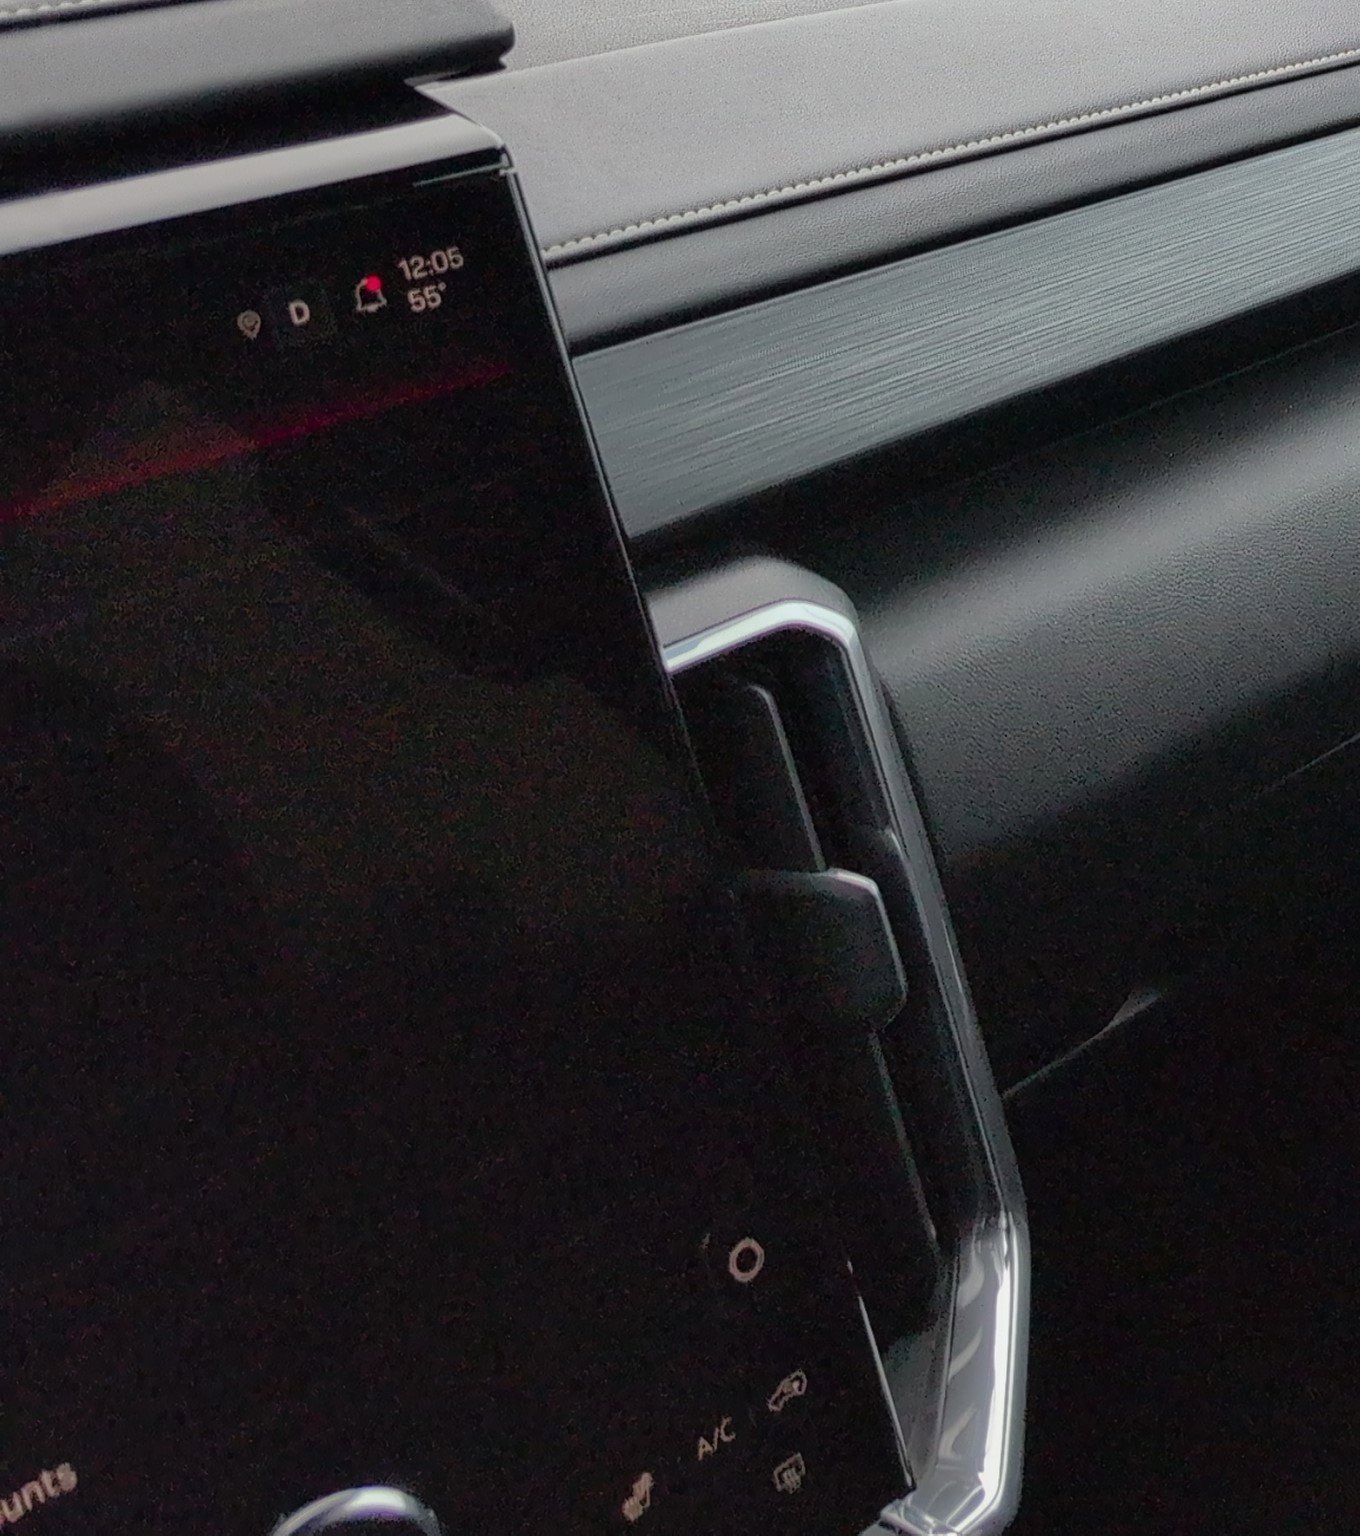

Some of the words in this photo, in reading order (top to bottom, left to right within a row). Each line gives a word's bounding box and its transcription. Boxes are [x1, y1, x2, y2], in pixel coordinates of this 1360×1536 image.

[398, 246, 464, 281] 12:05
[288, 299, 311, 326] D
[407, 281, 447, 312] 55°
[698, 1416, 736, 1461] A/C
[0, 1462, 78, 1530] unts
